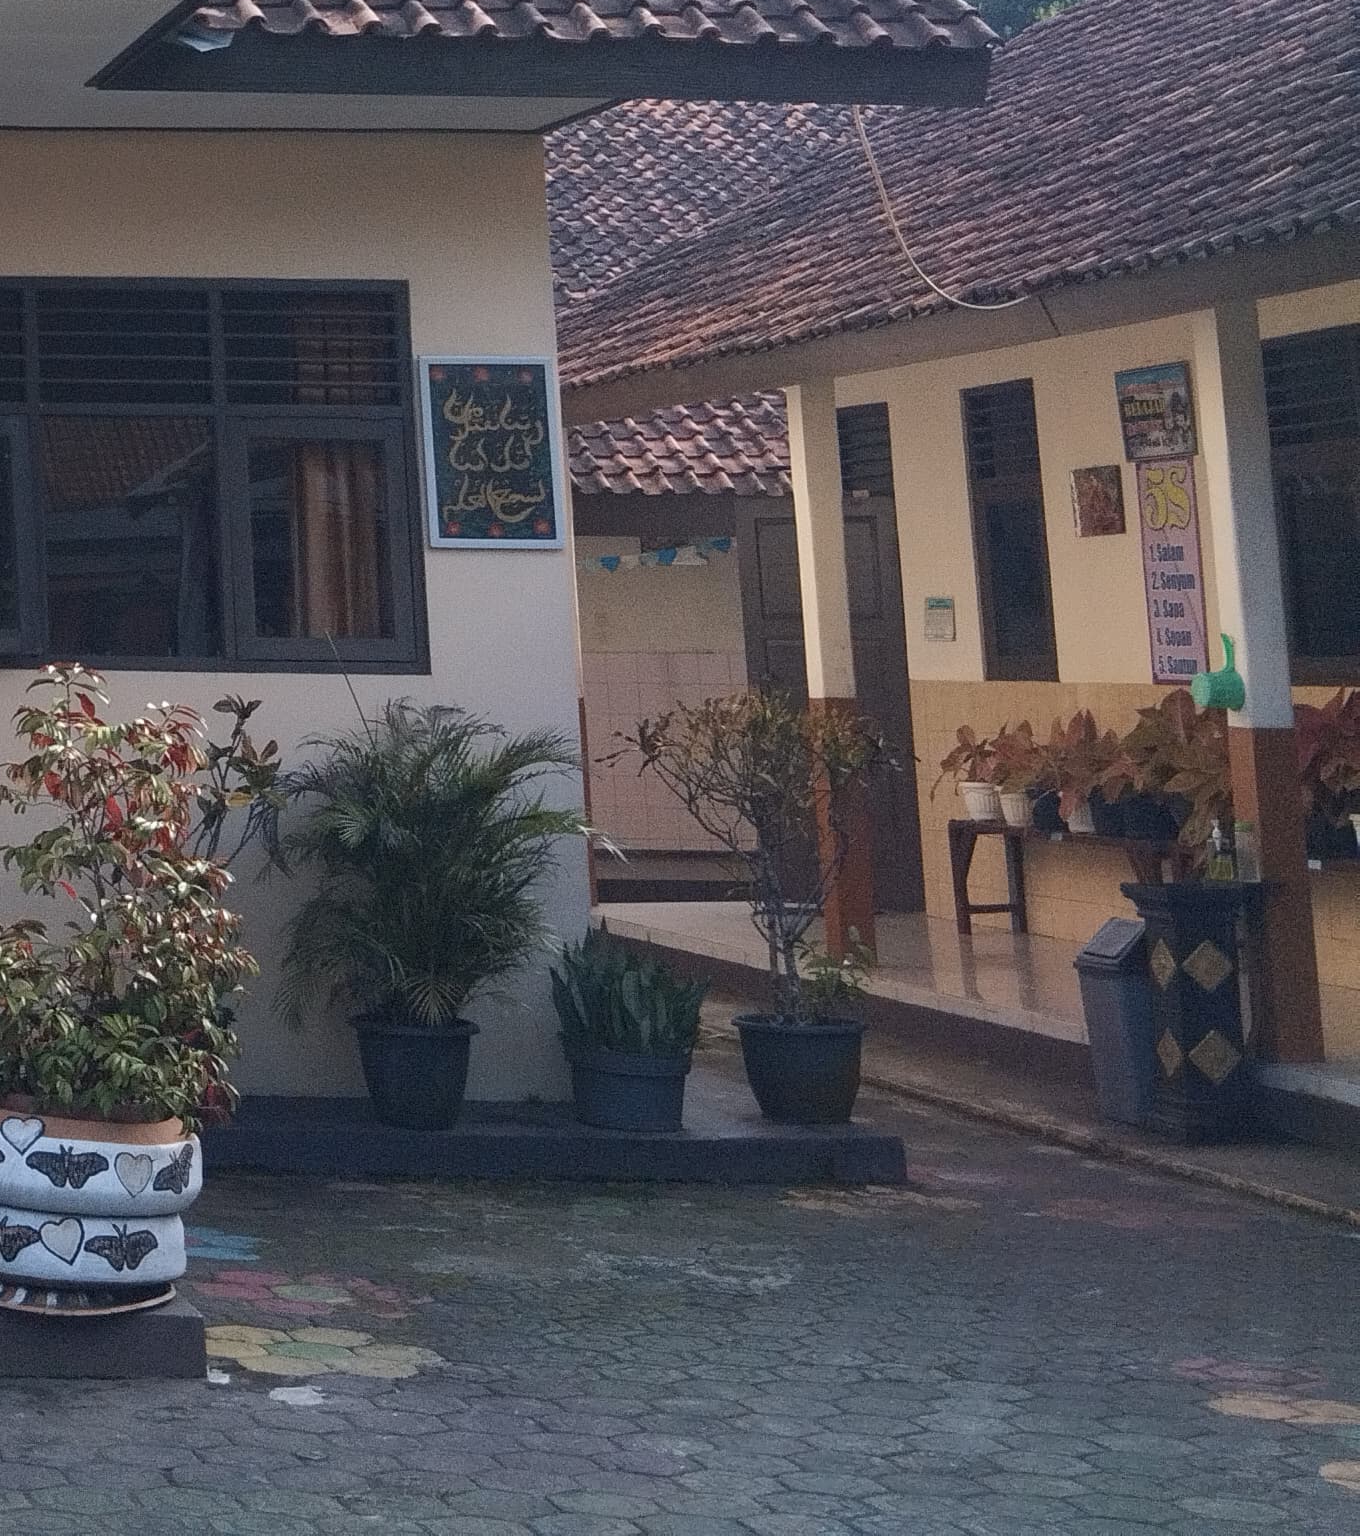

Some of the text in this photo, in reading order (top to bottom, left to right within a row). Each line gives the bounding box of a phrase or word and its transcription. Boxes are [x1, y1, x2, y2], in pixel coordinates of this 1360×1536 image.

[1144, 466, 1191, 531] 5S
[1157, 543, 1185, 562] Salam
[1160, 571, 1196, 592] Senyum
[1163, 599, 1185, 619] Sapa
[1165, 627, 1192, 647] Sopan
[1168, 655, 1198, 675] Santun
